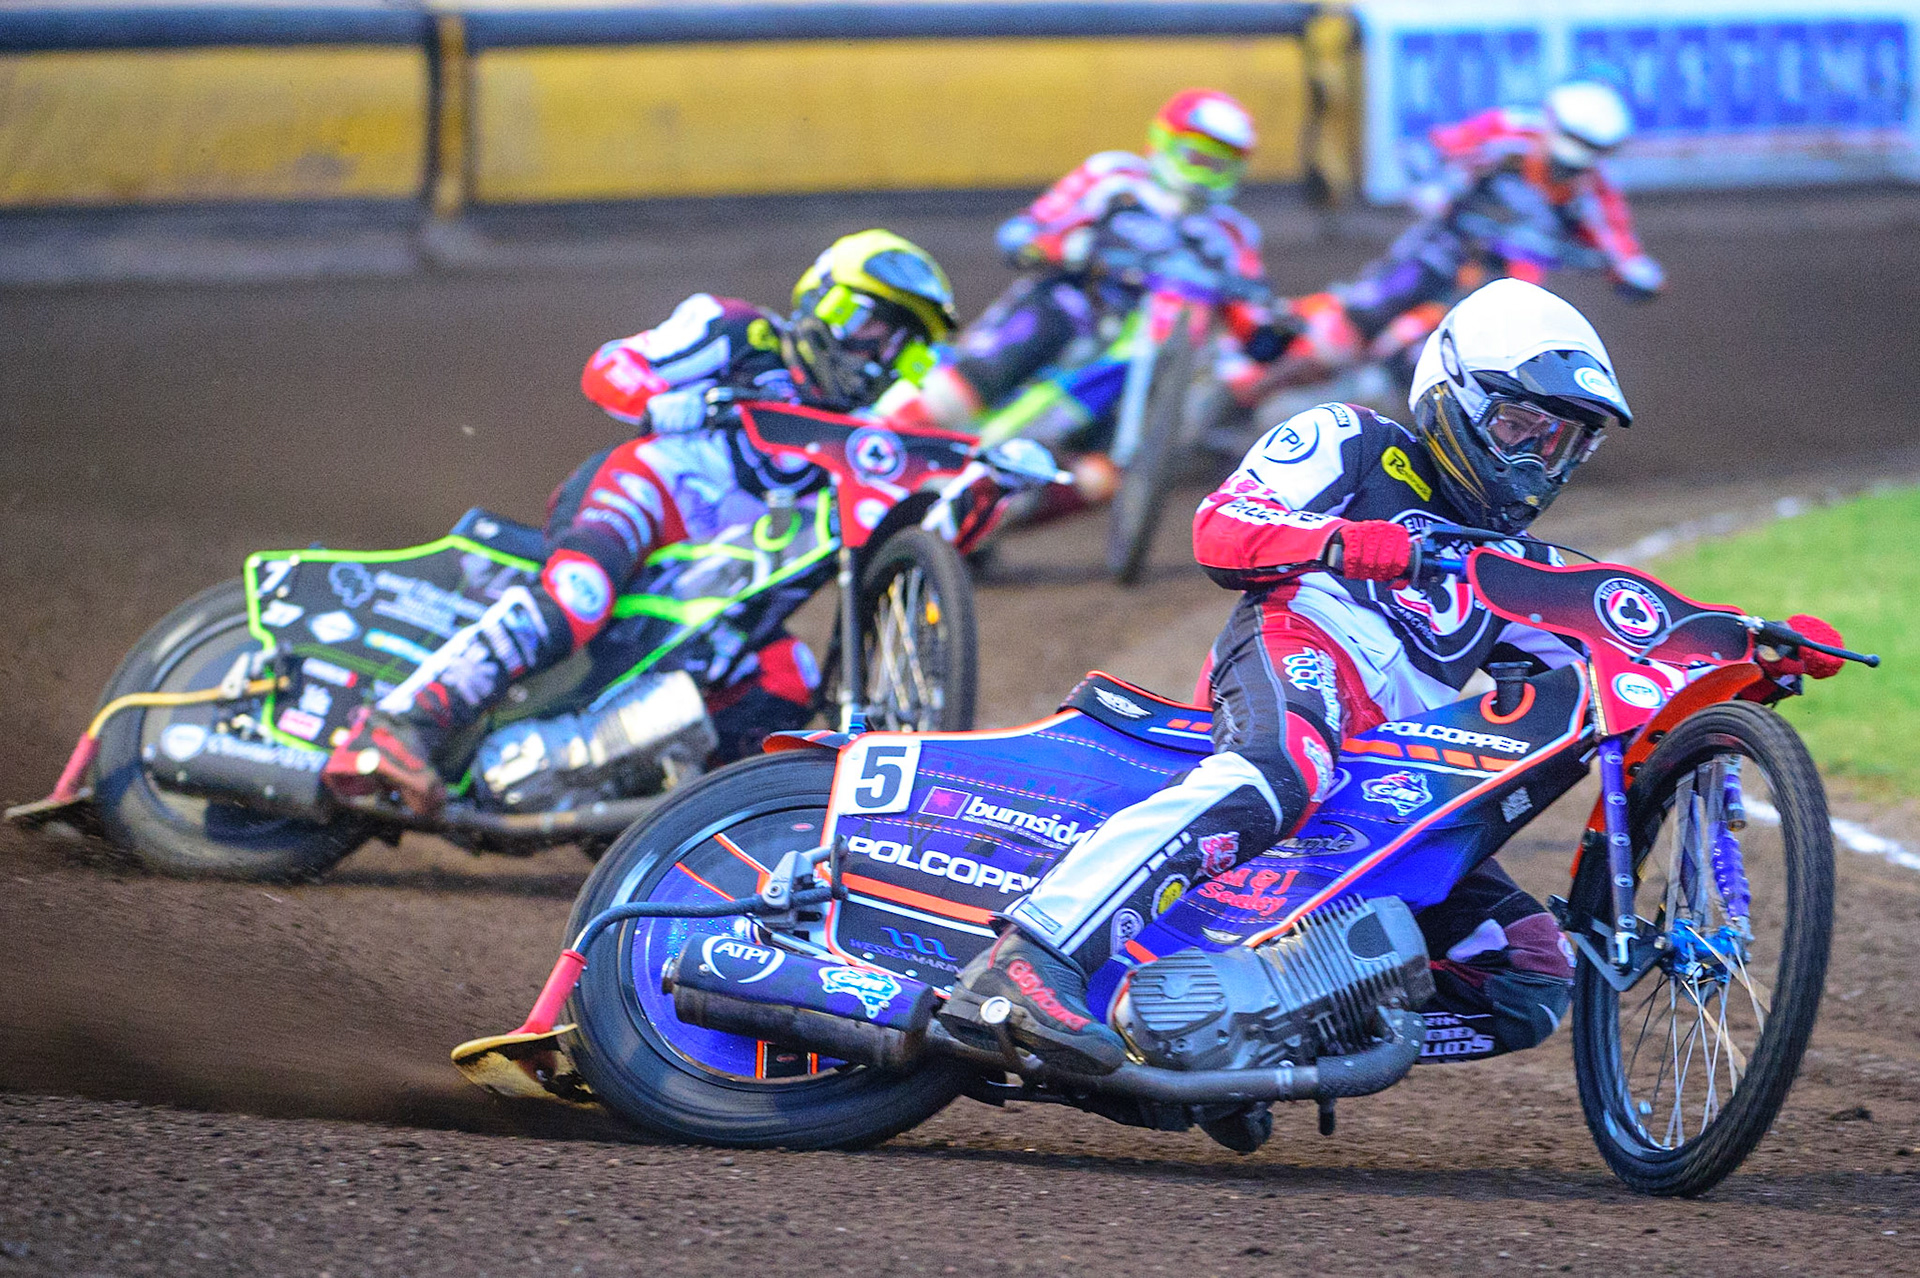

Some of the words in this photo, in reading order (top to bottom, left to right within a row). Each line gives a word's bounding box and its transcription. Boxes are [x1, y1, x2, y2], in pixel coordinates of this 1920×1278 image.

[1377, 721, 1531, 754] POLCOPPER
[855, 746, 907, 809] 5
[849, 835, 1040, 894] POLCOPP
[1272, 870, 1299, 895] J
[714, 942, 771, 964] ATPI
